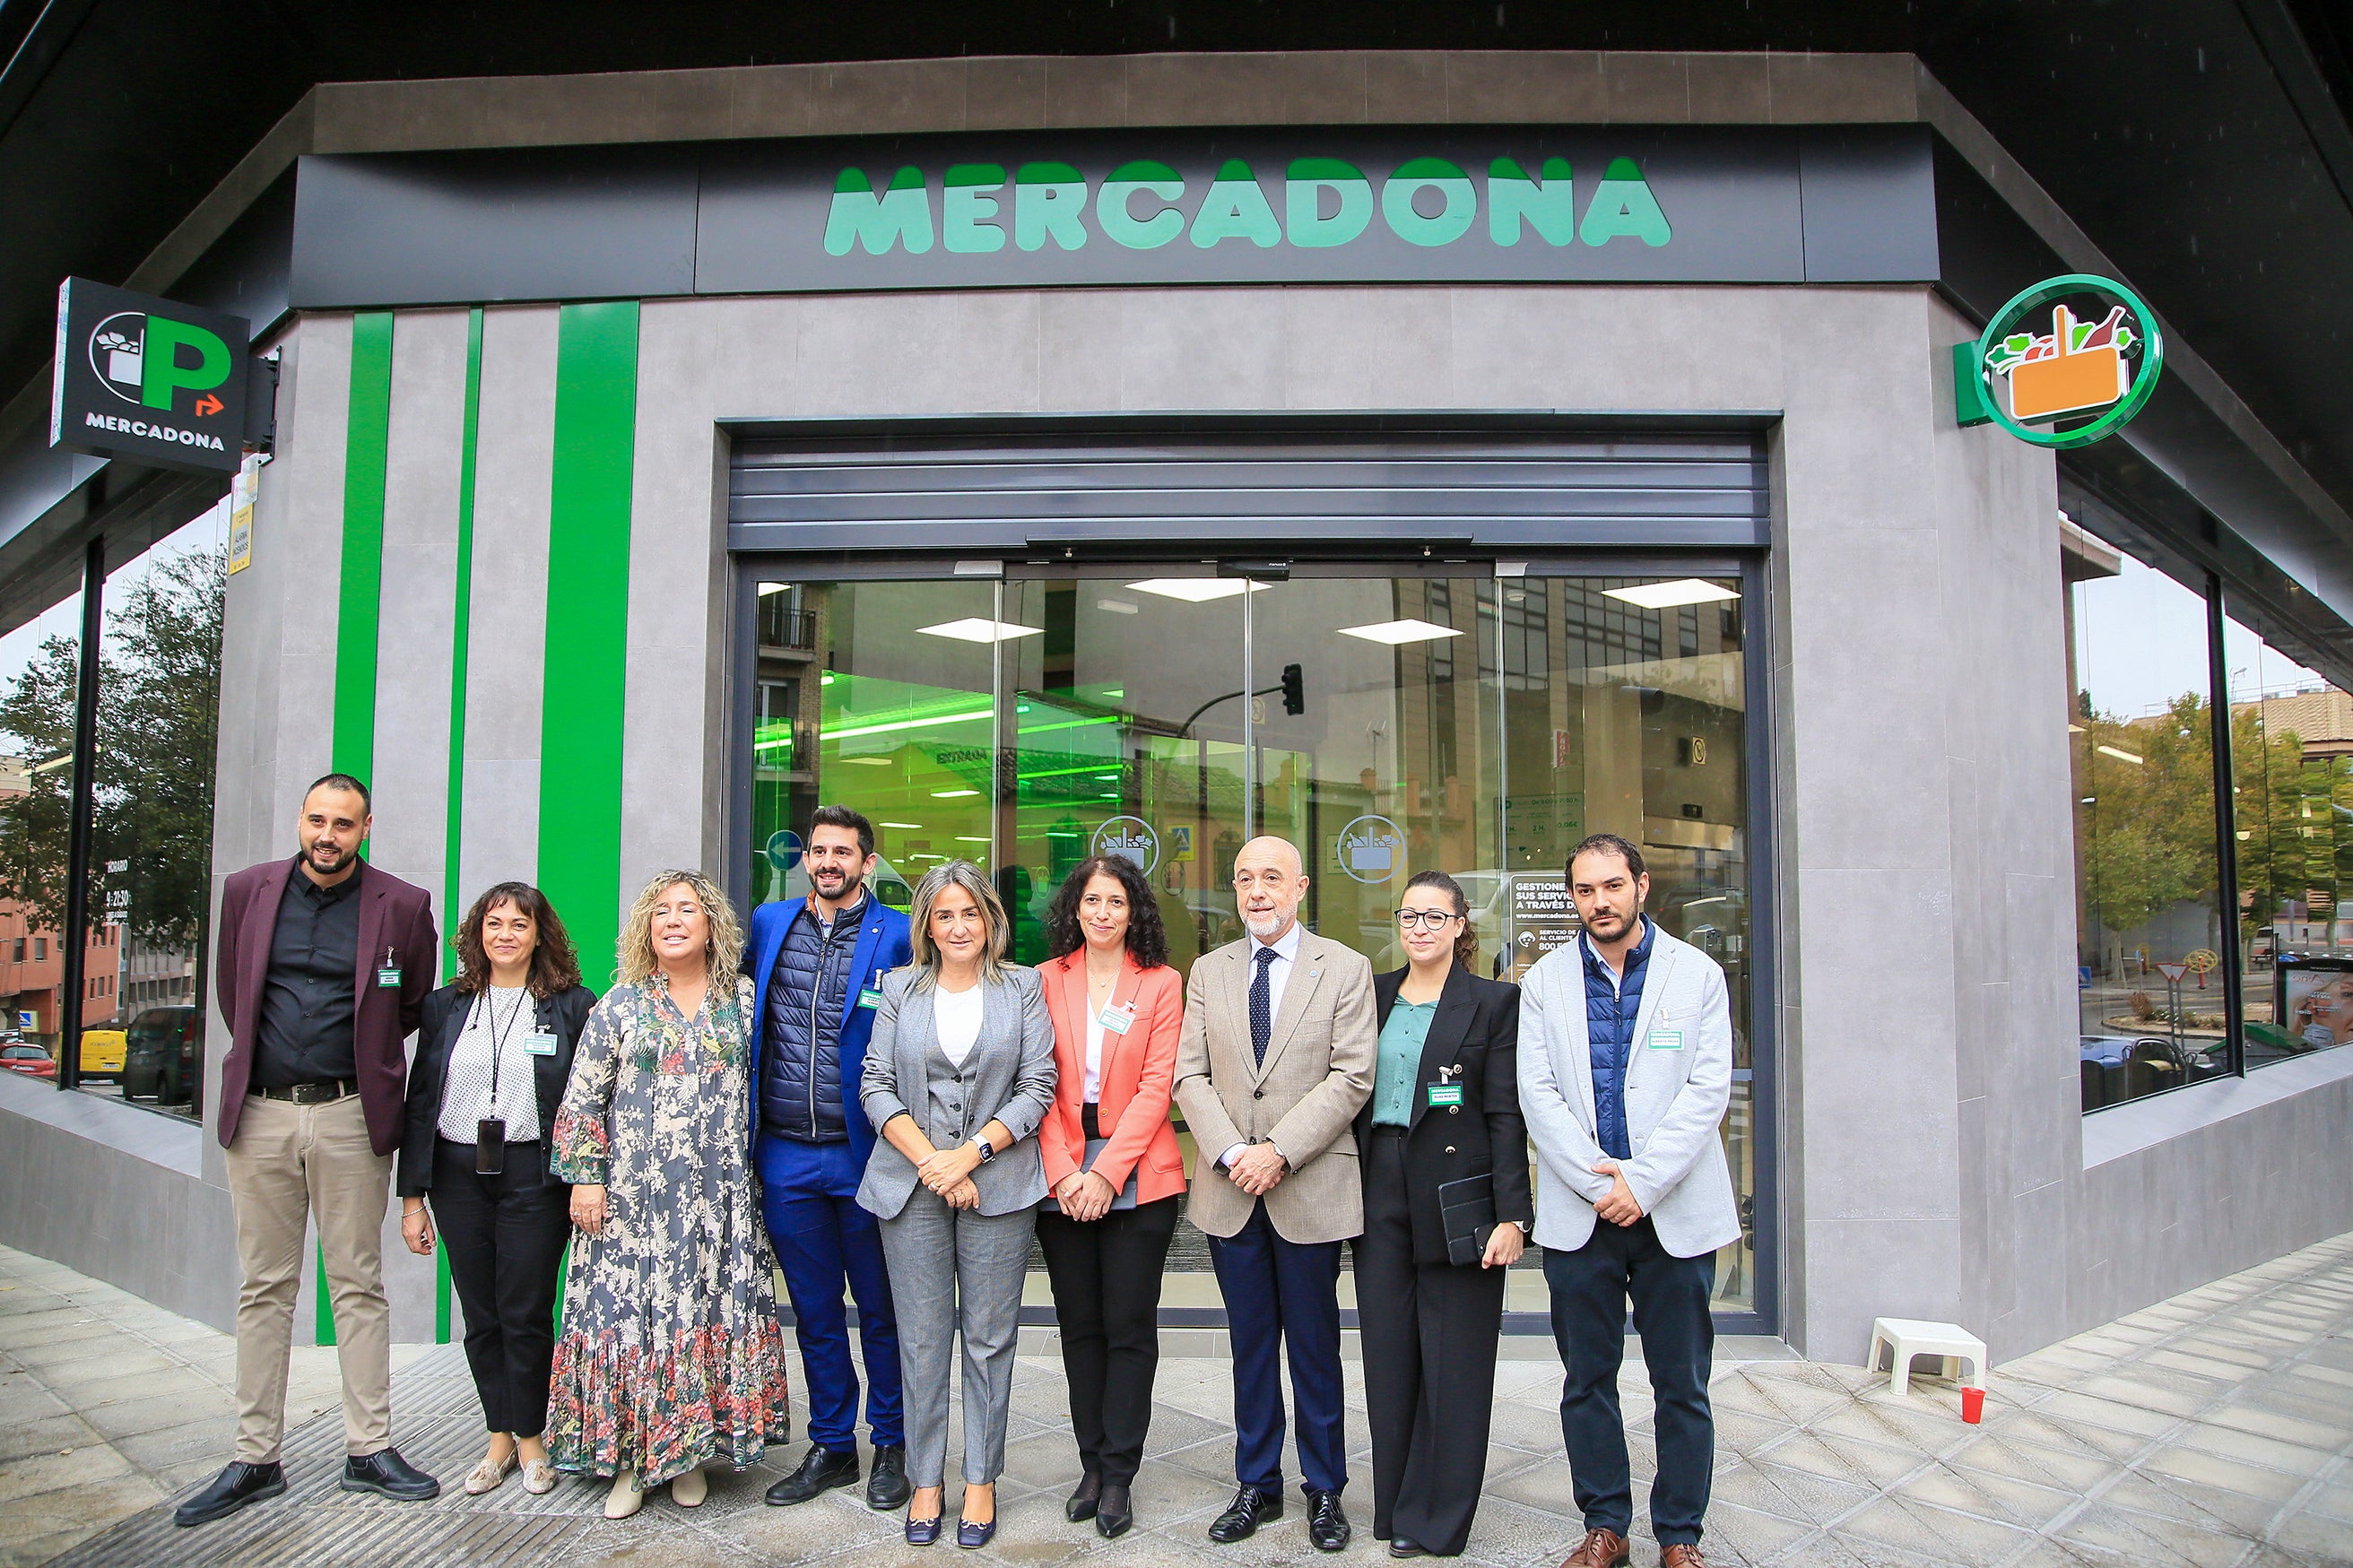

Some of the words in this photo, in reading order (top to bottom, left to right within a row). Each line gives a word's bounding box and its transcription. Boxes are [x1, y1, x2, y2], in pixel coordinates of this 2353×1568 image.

[822, 156, 1673, 256] MERCADONA
[142, 315, 232, 411] P
[85, 411, 225, 452] MERCADONA
[1515, 882, 1566, 891] GESTIONE
[1515, 892, 1536, 900] SUS
[1515, 901, 1524, 909] A
[1526, 899, 1565, 909] TRAVÉS
[1567, 901, 1576, 909] D
[1538, 942, 1556, 950] 800
